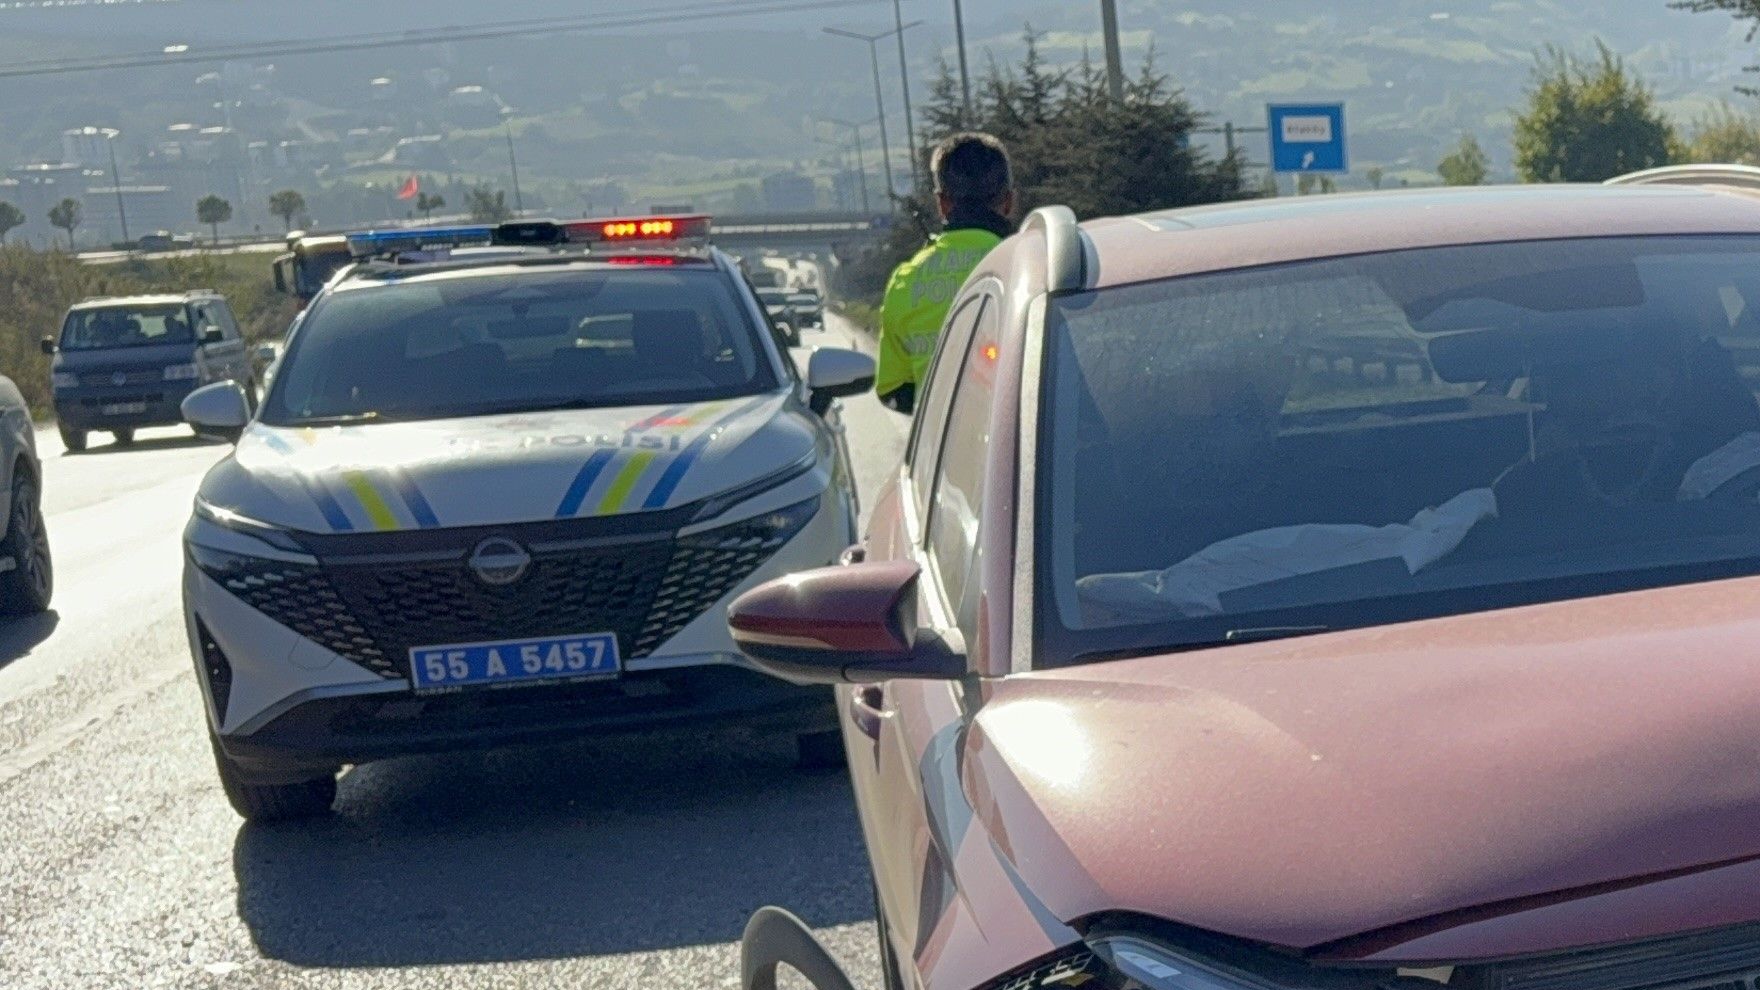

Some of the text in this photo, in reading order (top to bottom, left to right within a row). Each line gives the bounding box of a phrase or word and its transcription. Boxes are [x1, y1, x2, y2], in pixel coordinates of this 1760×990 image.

[424, 650, 469, 682] 55
[486, 648, 507, 677] A
[520, 639, 606, 674] 5457
